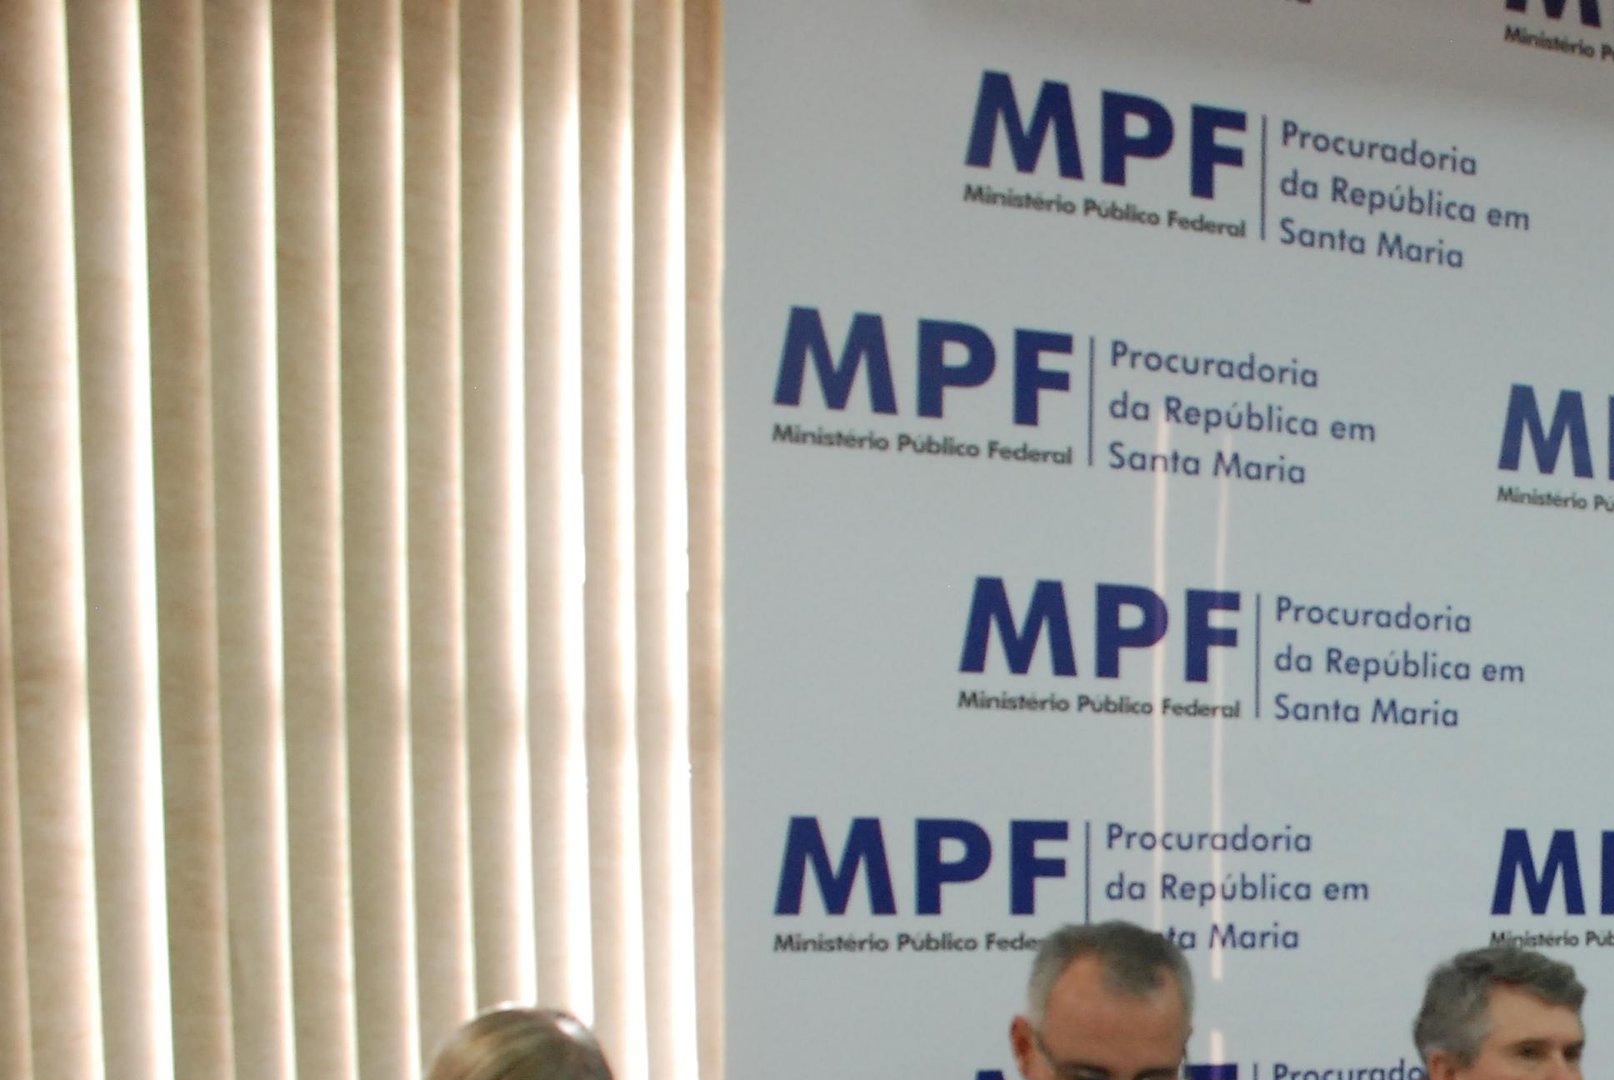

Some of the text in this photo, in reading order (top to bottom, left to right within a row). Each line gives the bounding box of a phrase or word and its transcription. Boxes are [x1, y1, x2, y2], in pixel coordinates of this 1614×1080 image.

[1504, 25, 1595, 59] Ministério
[964, 70, 1248, 200] MPF
[1281, 120, 1477, 176] Procuradoria
[963, 183, 1246, 239] Ministério Público Federal
[1280, 170, 1530, 231] da República em
[1280, 219, 1464, 270] Santa Maria
[773, 306, 1073, 426] MPF
[1111, 341, 1319, 388] Procuradoria
[1109, 392, 1376, 442] da República em
[772, 425, 1072, 466] Ministério Público Federal
[1108, 441, 1305, 486] Santa Maria
[1497, 486, 1588, 510] Ministério
[959, 576, 1241, 682] MPF
[1276, 596, 1472, 635] Procuradoria
[1274, 644, 1525, 686] da República em
[958, 691, 1240, 719] Ministério Público Federal
[1274, 694, 1458, 728] Santa Maria
[1107, 824, 1312, 854] Procuradoria
[773, 816, 1069, 916] MPF
[1106, 873, 1369, 908] da República em
[773, 932, 1043, 952] Ministério Público Fede
[1208, 922, 1300, 950] Maria
